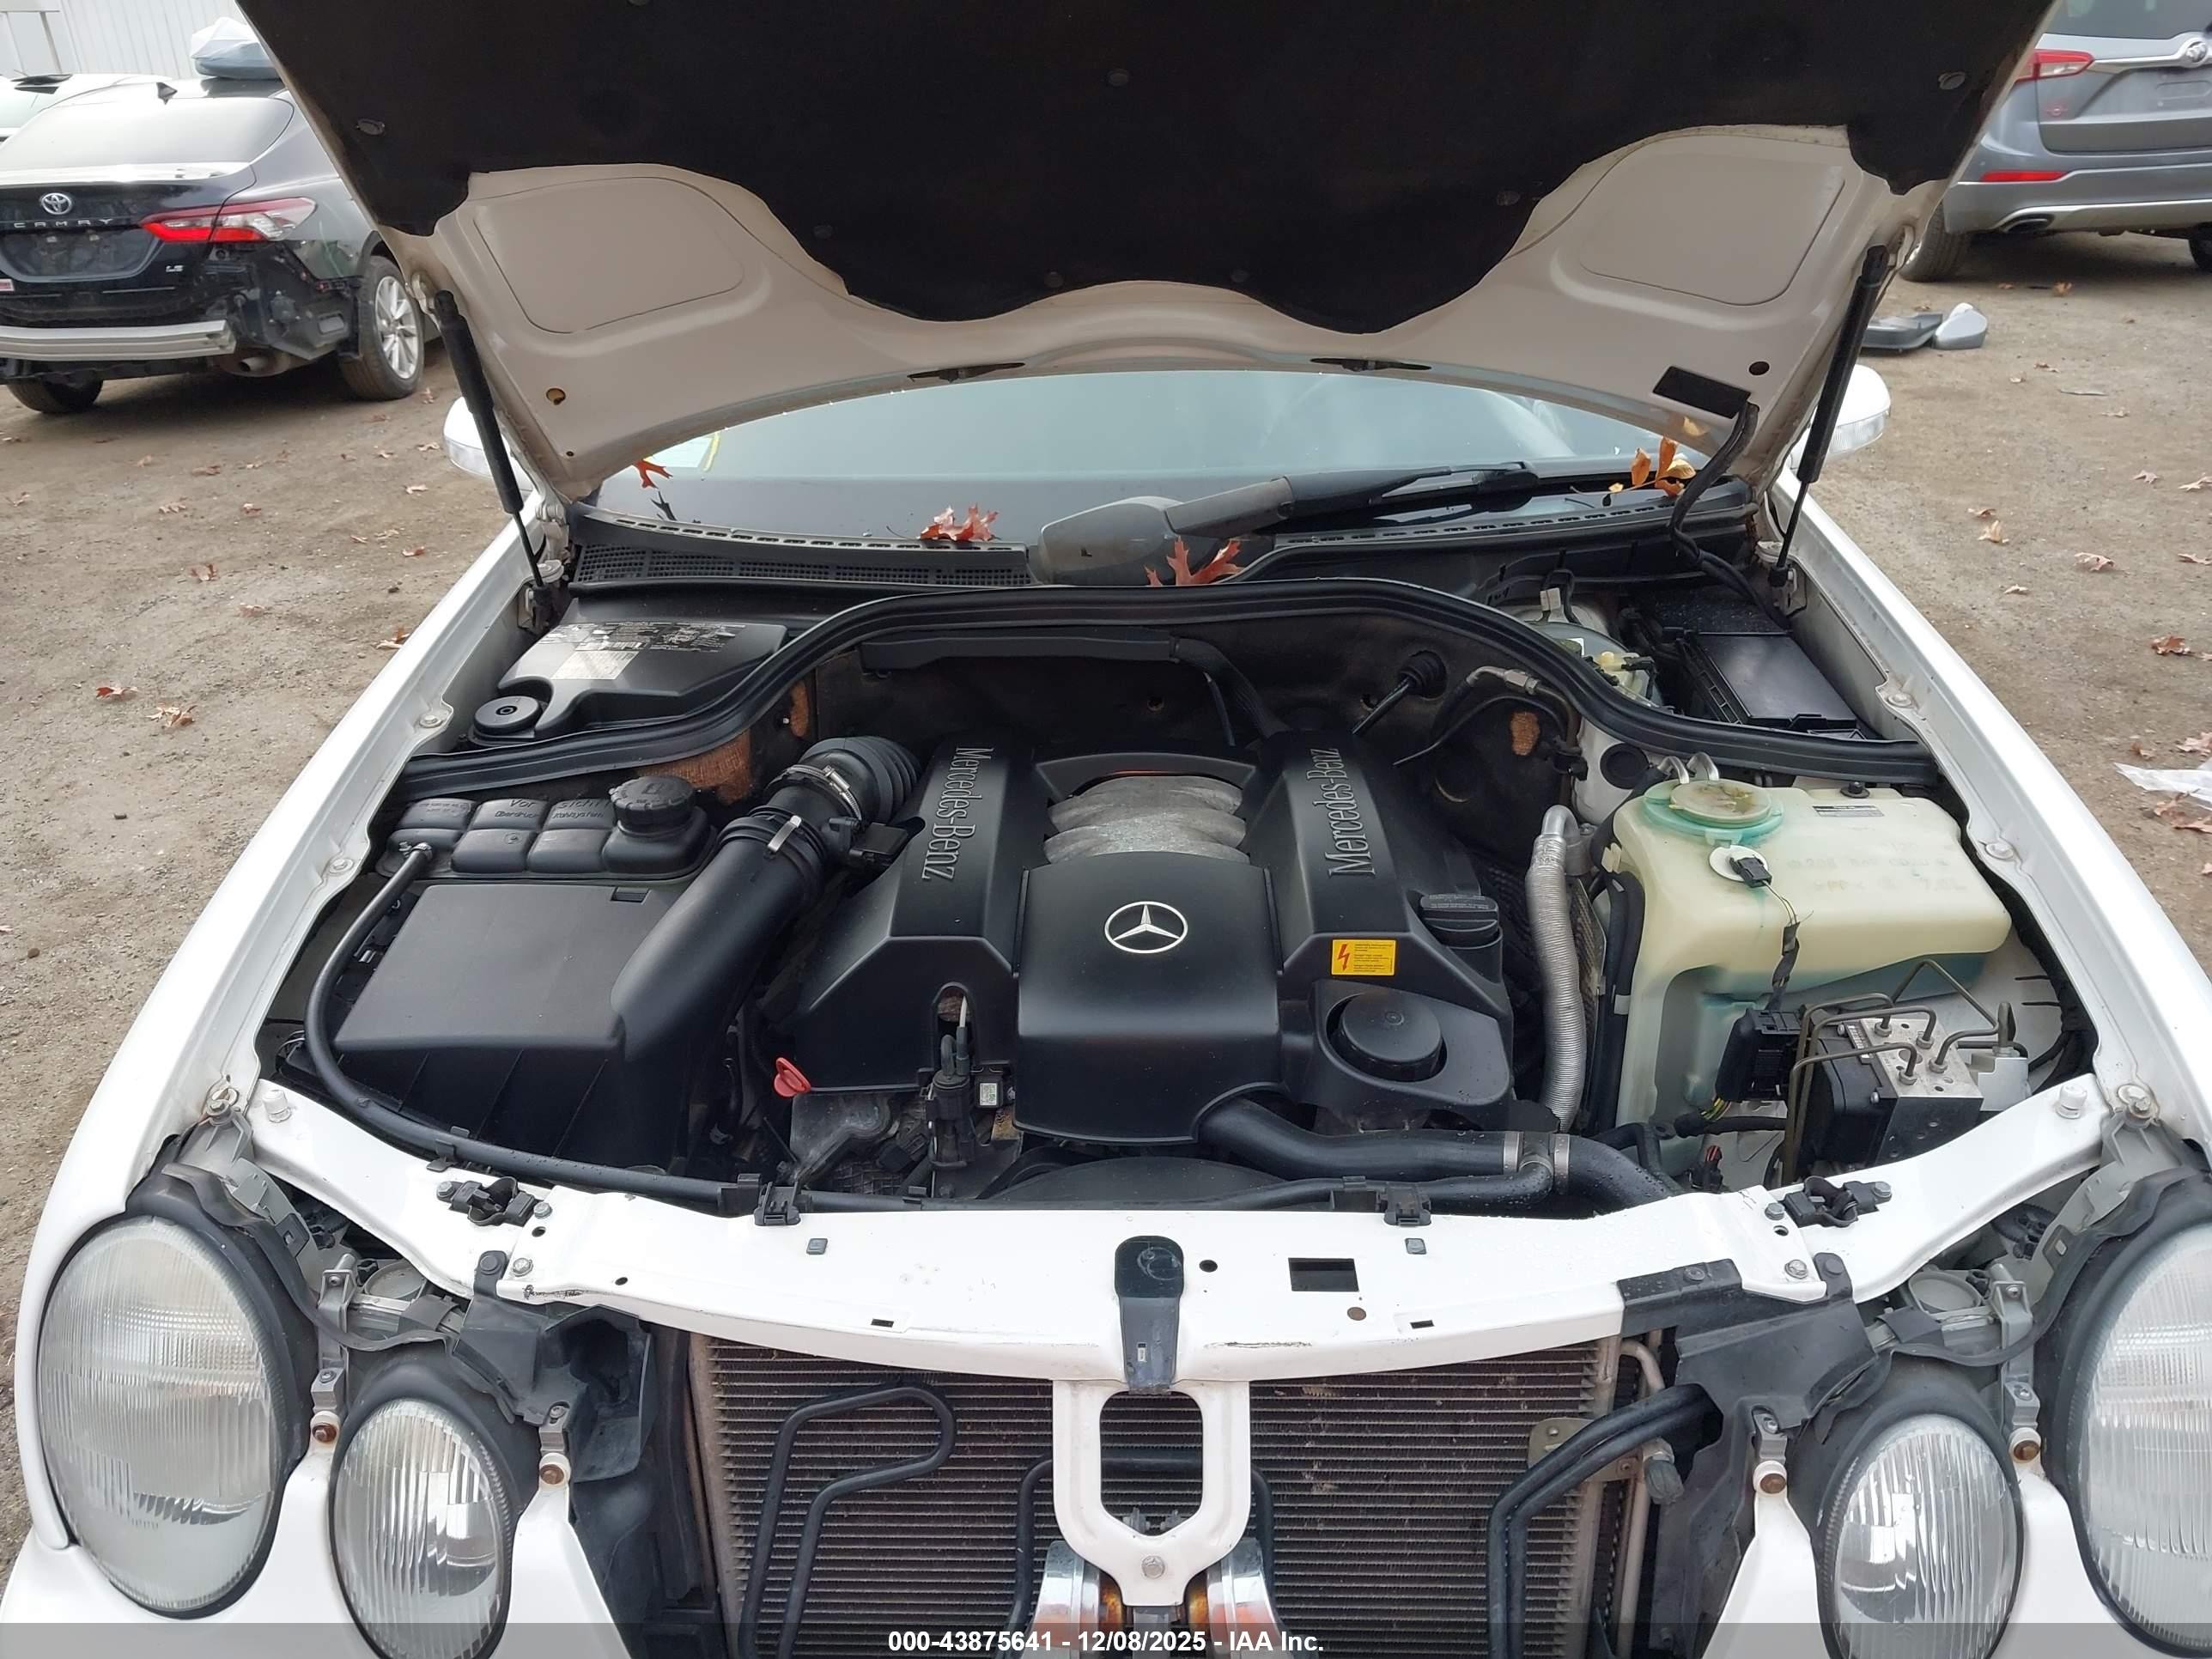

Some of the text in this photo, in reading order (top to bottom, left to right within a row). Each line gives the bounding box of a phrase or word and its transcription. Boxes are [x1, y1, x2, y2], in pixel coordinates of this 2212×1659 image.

[14, 218, 112, 228] CAMRY
[921, 747, 994, 879] Mercedes-Benz
[1306, 748, 1376, 876] Mercedes-Benz
